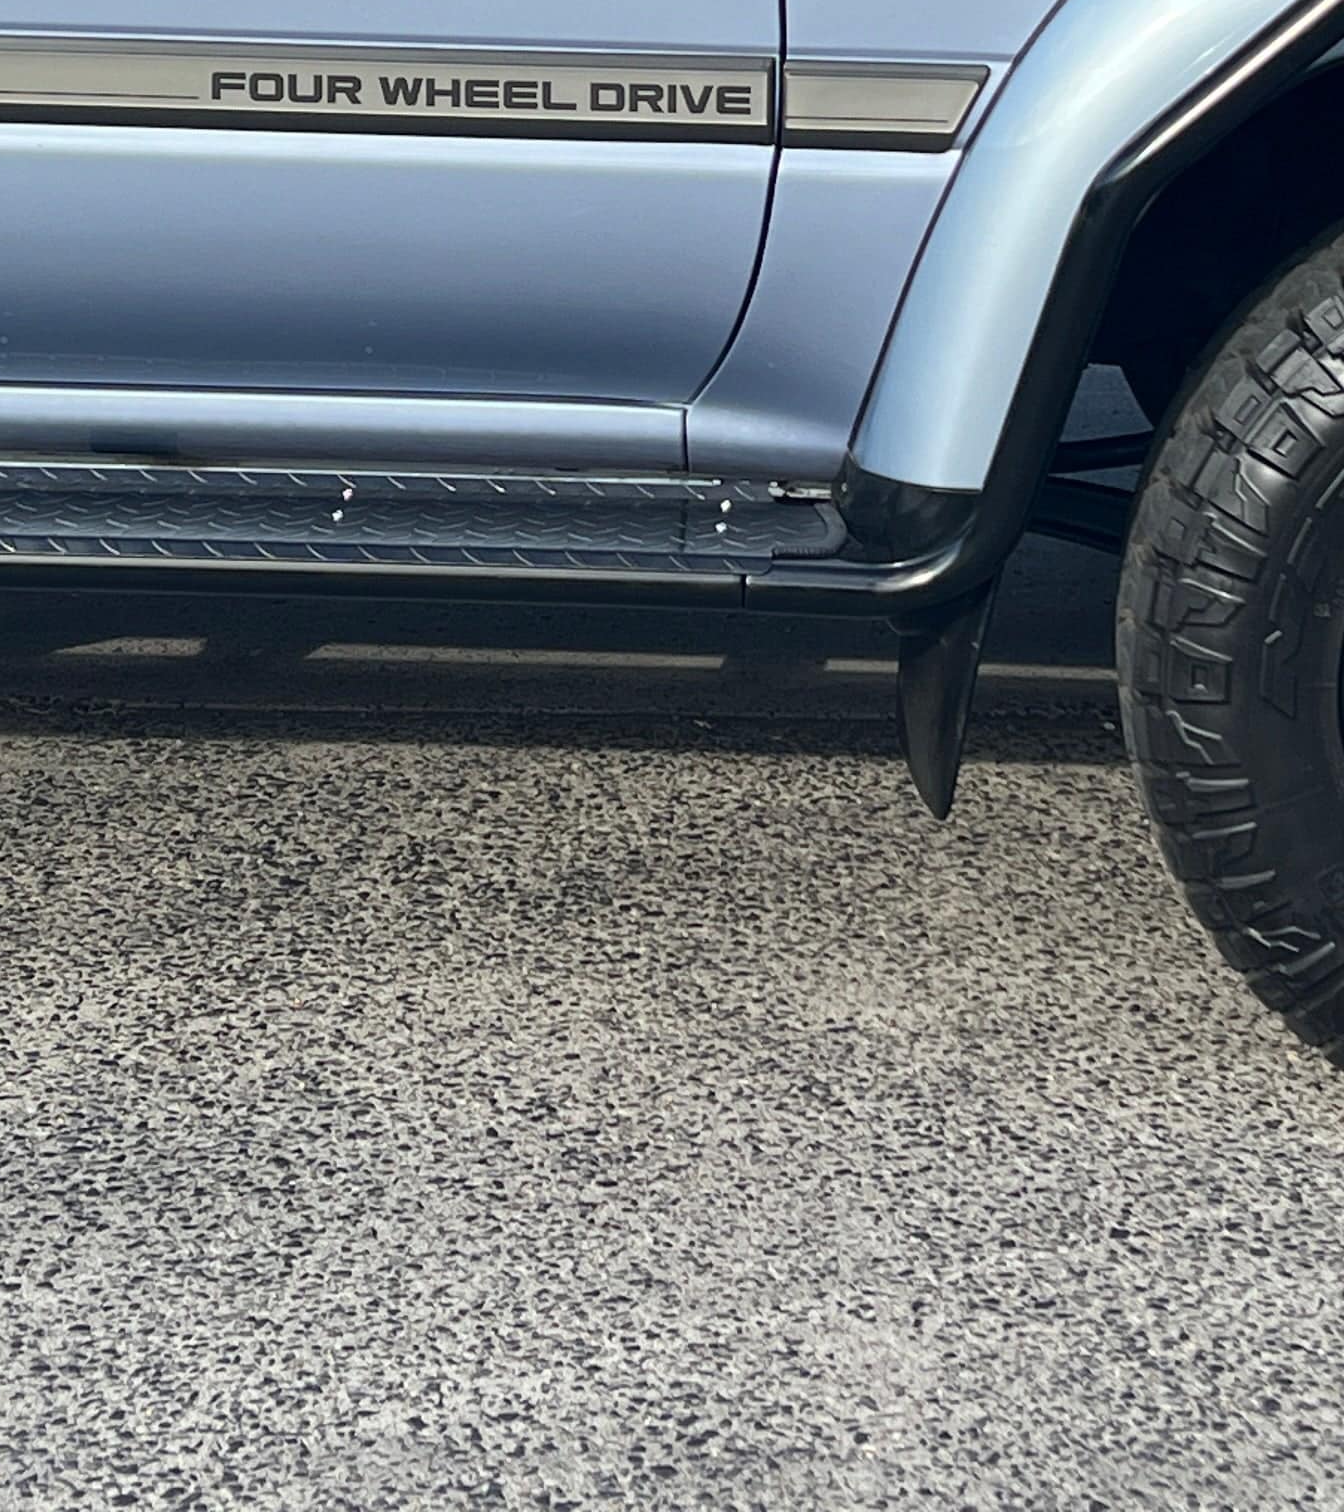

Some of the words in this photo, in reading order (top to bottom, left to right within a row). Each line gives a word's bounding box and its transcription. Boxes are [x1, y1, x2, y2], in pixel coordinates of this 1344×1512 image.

[210, 71, 363, 104] FOUR
[379, 76, 577, 111] WHEEL
[589, 81, 752, 115] DRIVE
